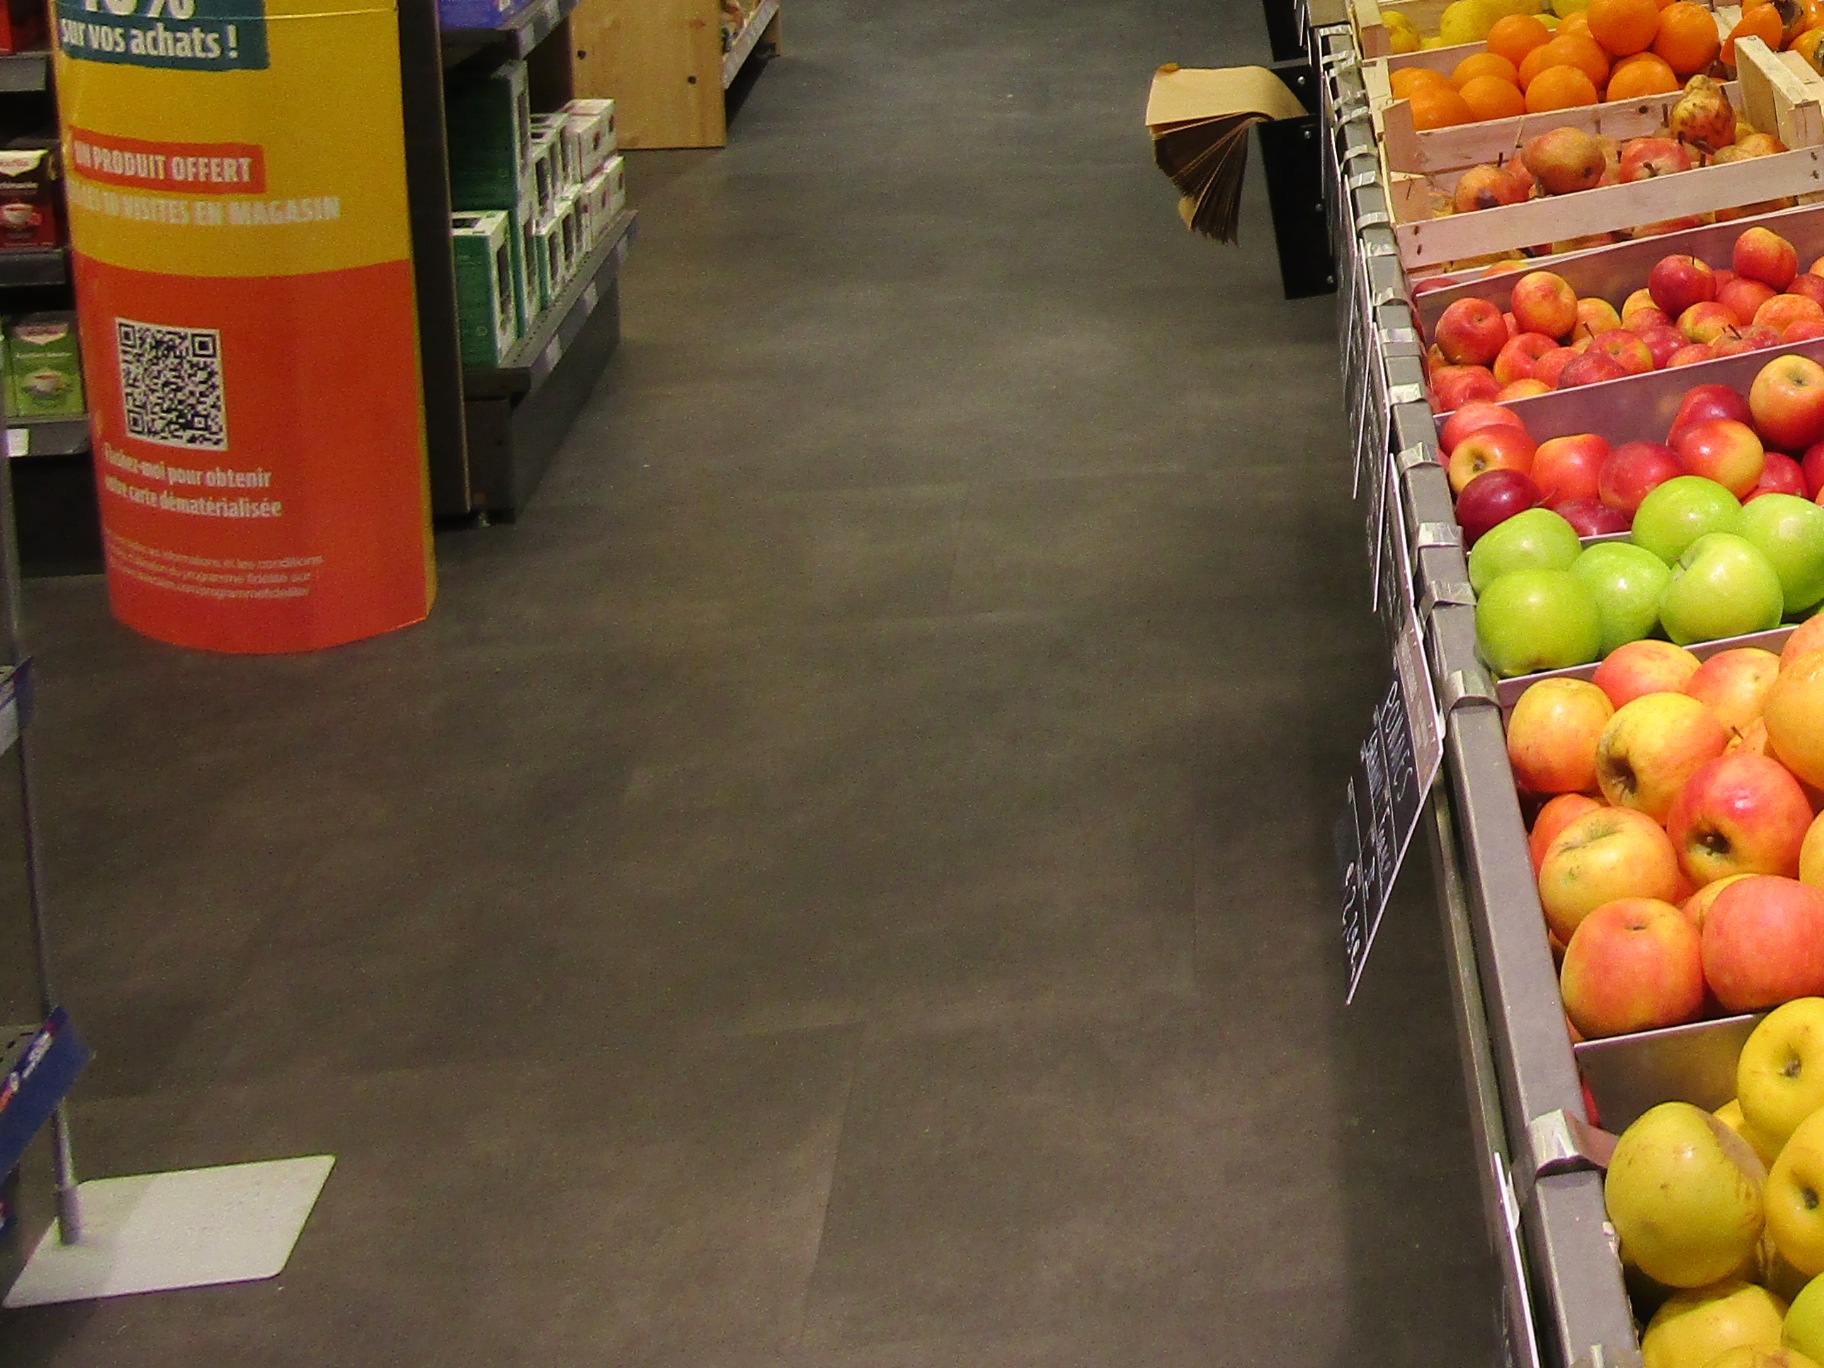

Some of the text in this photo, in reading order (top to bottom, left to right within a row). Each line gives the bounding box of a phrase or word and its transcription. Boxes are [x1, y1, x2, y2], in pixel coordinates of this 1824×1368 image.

[61, 17, 86, 47] sur
[87, 23, 127, 53] vos
[130, 22, 222, 60] achats
[92, 144, 167, 180] PRODUIT
[171, 156, 253, 183] OFFERT
[194, 200, 224, 226] EN
[229, 194, 341, 226] MAGASIN
[166, 466, 203, 486] pour
[205, 465, 273, 488] obtenir
[158, 489, 283, 519] dématérialisée
